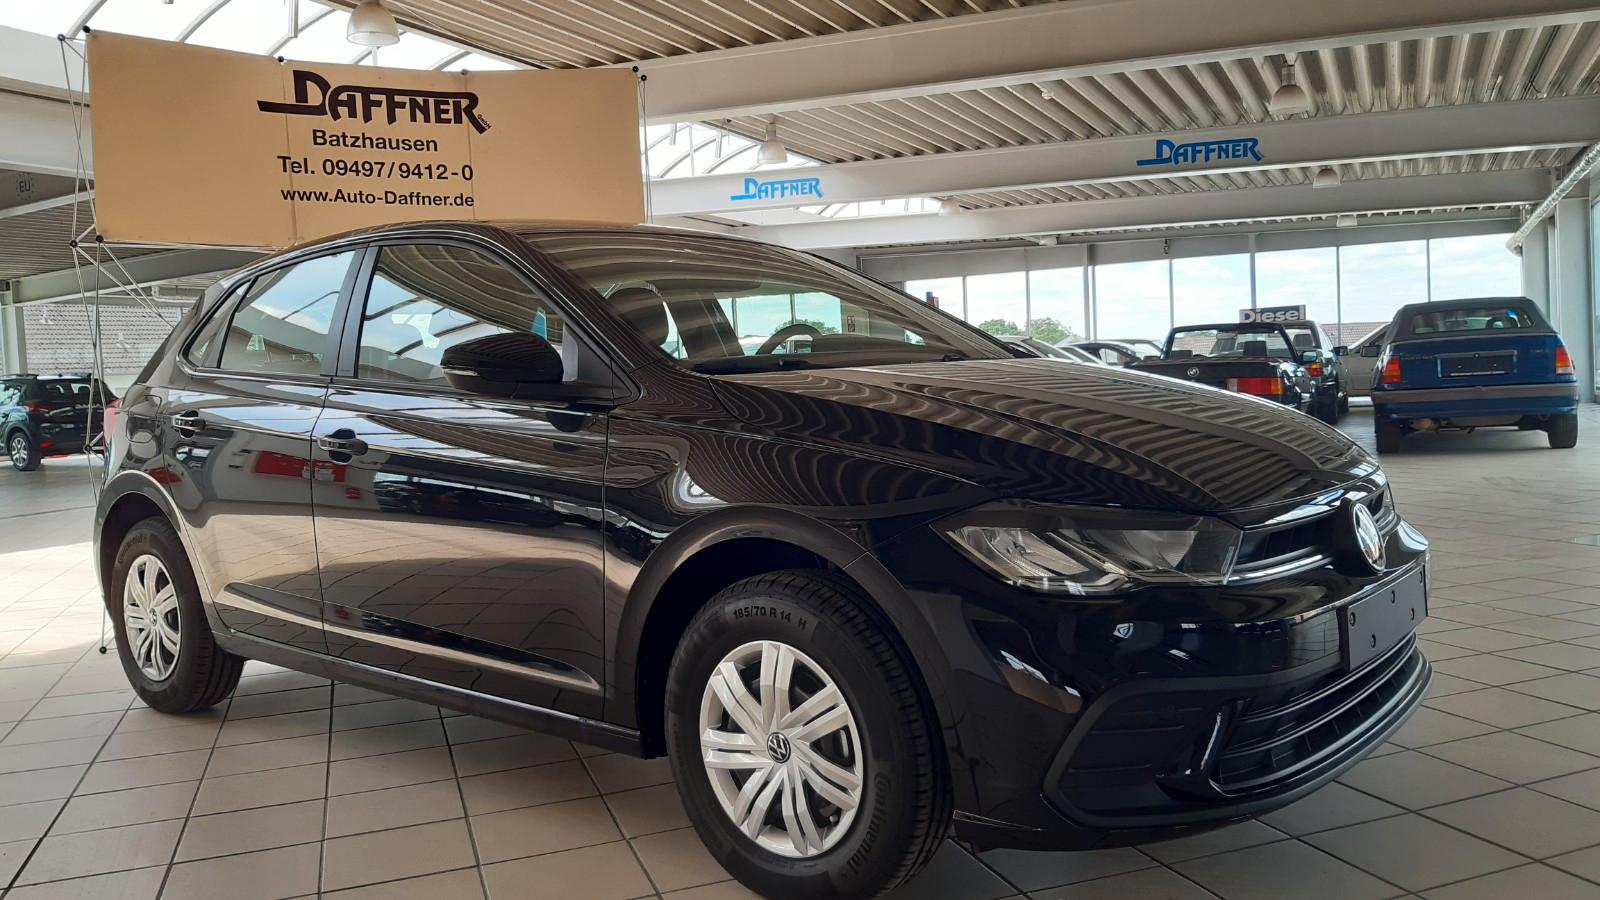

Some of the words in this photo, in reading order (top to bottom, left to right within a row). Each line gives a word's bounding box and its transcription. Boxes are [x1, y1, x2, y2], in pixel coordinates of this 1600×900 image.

[312, 129, 438, 152] Batzhausen
[277, 155, 316, 175] Tel.
[19, 180, 31, 192] EU
[281, 188, 475, 207] www.Auto-Daffner.de
[1239, 305, 1305, 323] Diesel
[733, 606, 767, 619] 185/70
[769, 607, 778, 618] R
[780, 610, 792, 621] 14
[798, 617, 808, 630] H
